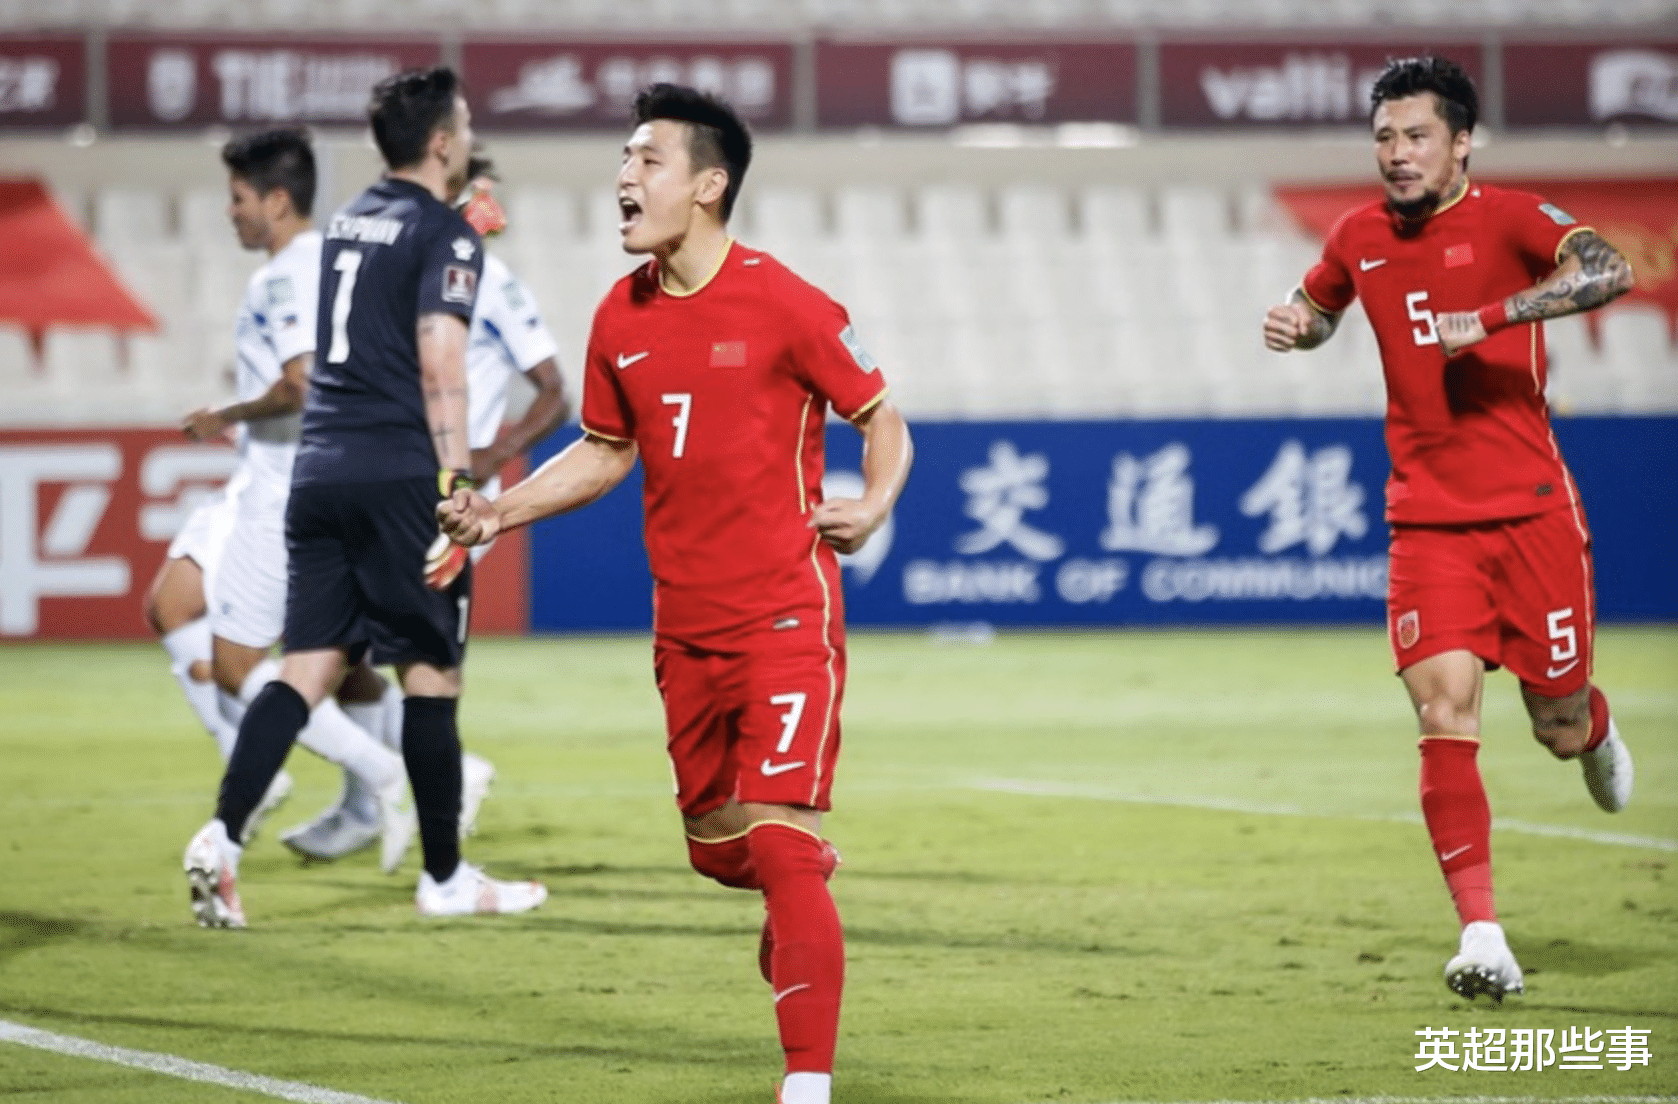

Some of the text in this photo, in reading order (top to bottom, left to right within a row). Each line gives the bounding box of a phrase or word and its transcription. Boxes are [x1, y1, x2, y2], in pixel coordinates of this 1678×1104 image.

[326, 250, 362, 364] 1
[1405, 291, 1439, 346] 5
[661, 393, 693, 459] 7
[904, 560, 1041, 603] BANK
[1056, 558, 1127, 602] OF
[1546, 608, 1578, 661] 5
[769, 692, 808, 753] 7
